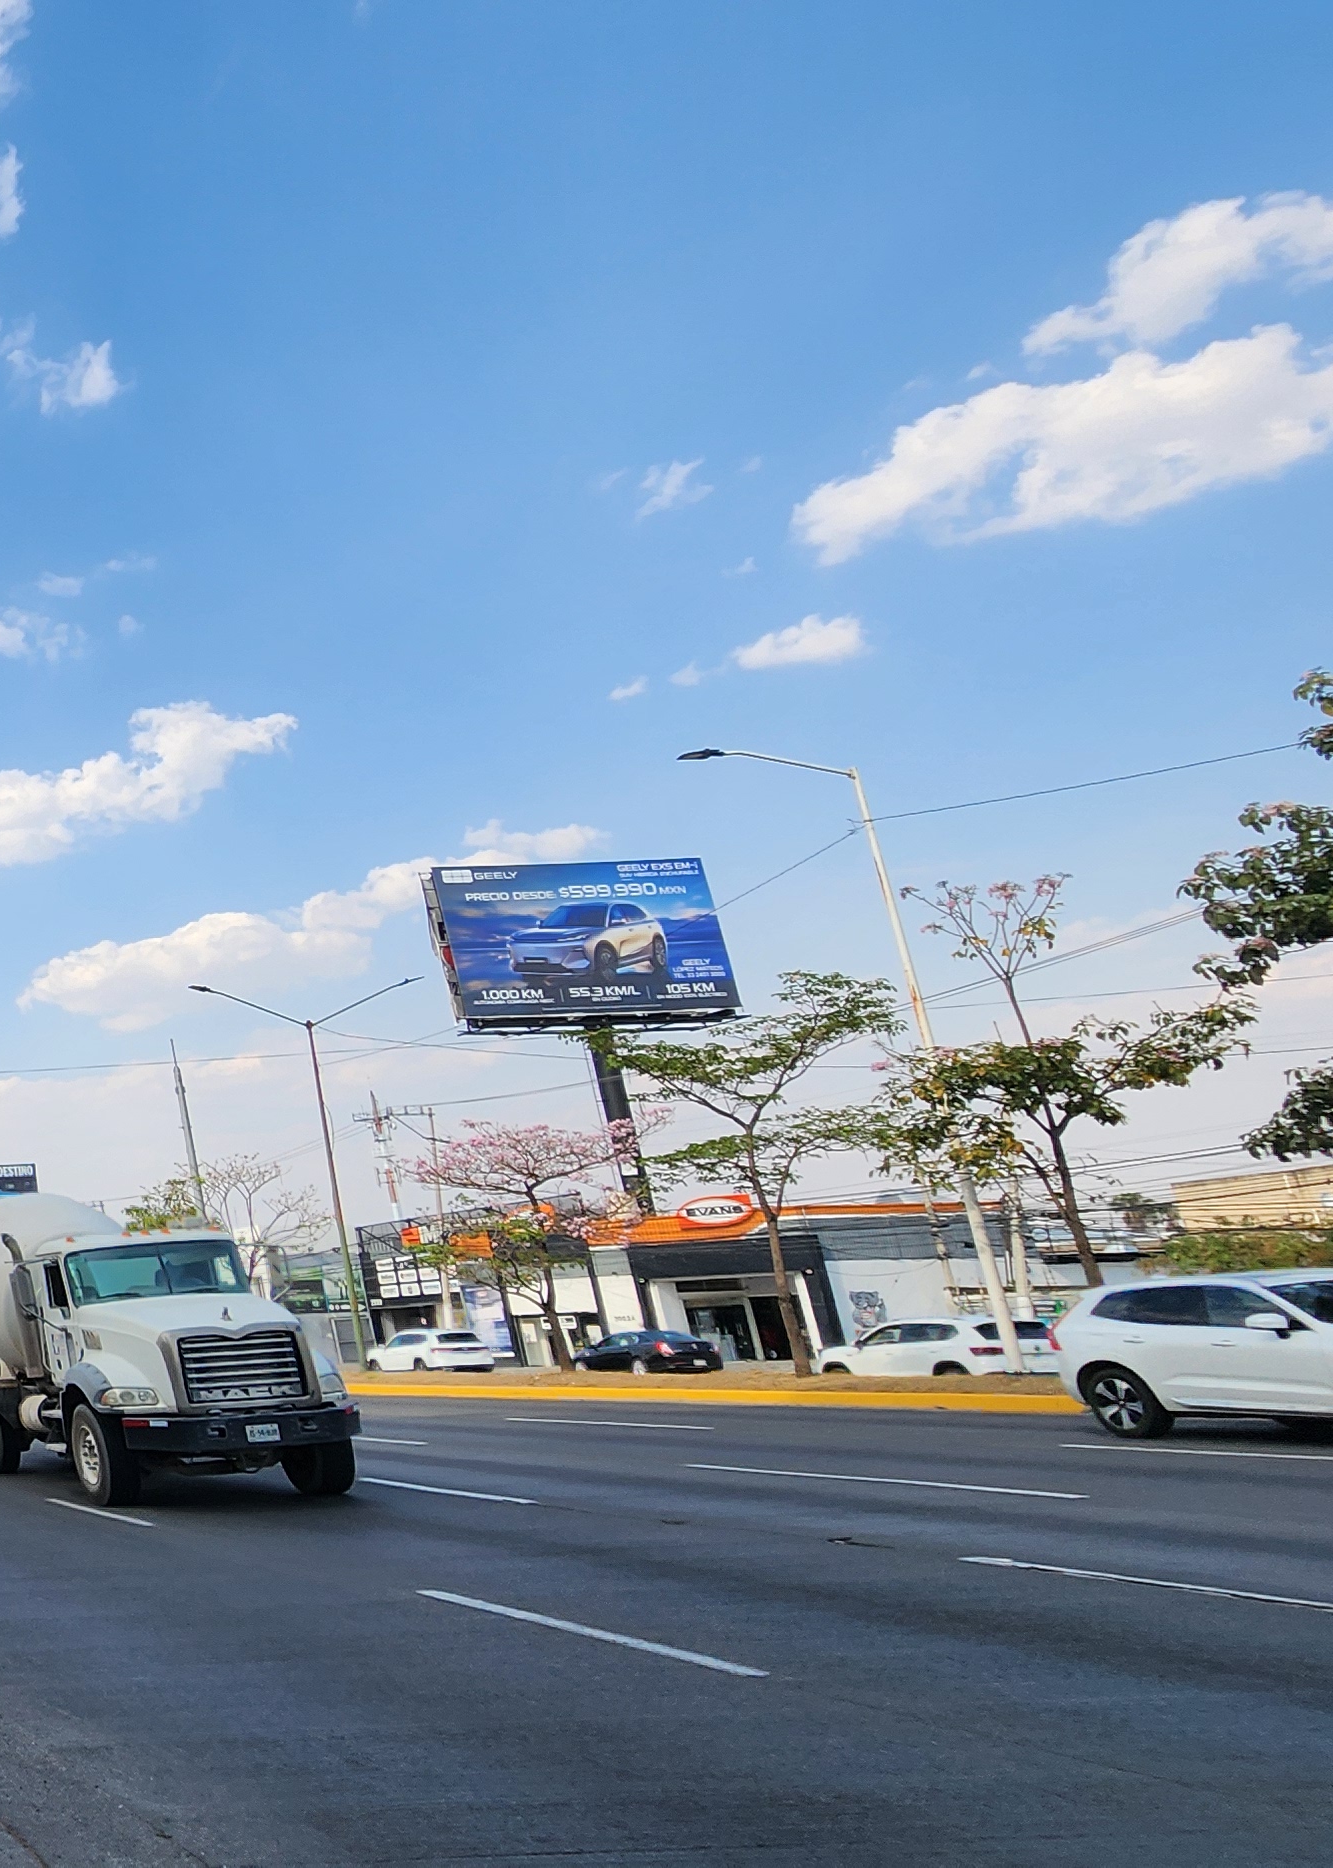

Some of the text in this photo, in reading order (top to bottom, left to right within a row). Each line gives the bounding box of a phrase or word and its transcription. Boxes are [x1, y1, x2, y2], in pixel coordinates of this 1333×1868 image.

[616, 864, 650, 873] GEELY
[473, 871, 518, 881] GEELY
[465, 892, 509, 902] PRECIO
[514, 890, 555, 901] DESDE
[659, 885, 687, 895] MXN
[681, 958, 711, 966] GEELY
[605, 985, 642, 996] KM/L
[665, 981, 716, 994] 105 KM
[521, 988, 545, 999] KM
[686, 1206, 744, 1216] EVANS
